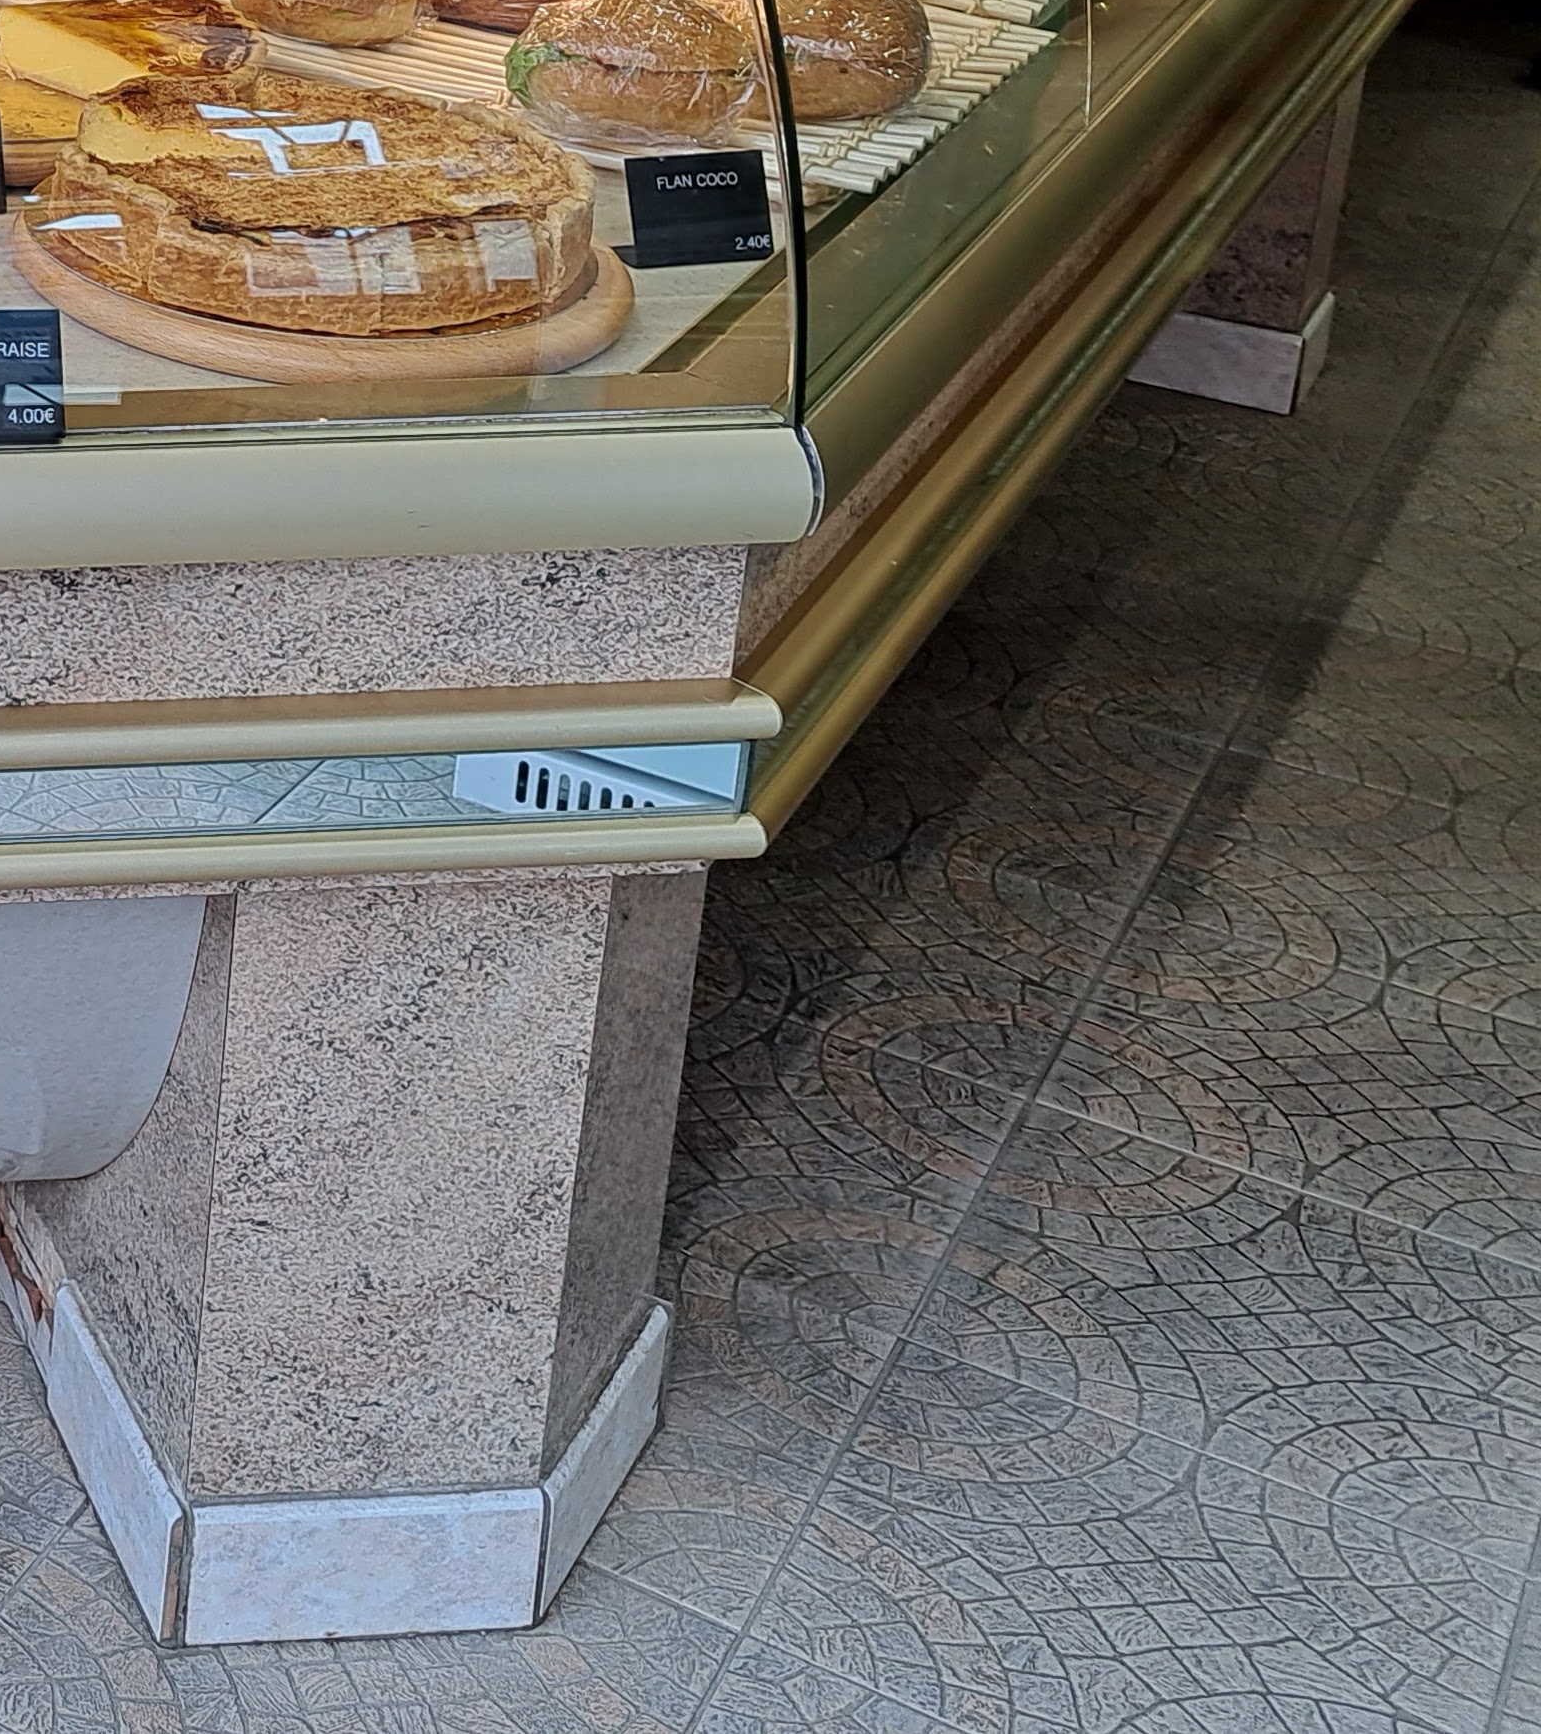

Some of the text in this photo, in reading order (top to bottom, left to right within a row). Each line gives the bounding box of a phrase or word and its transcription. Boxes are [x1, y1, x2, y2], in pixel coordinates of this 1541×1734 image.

[656, 171, 739, 191] FLAN COCO
[734, 234, 771, 251] 2.40€
[7, 407, 56, 425] 4.00€
